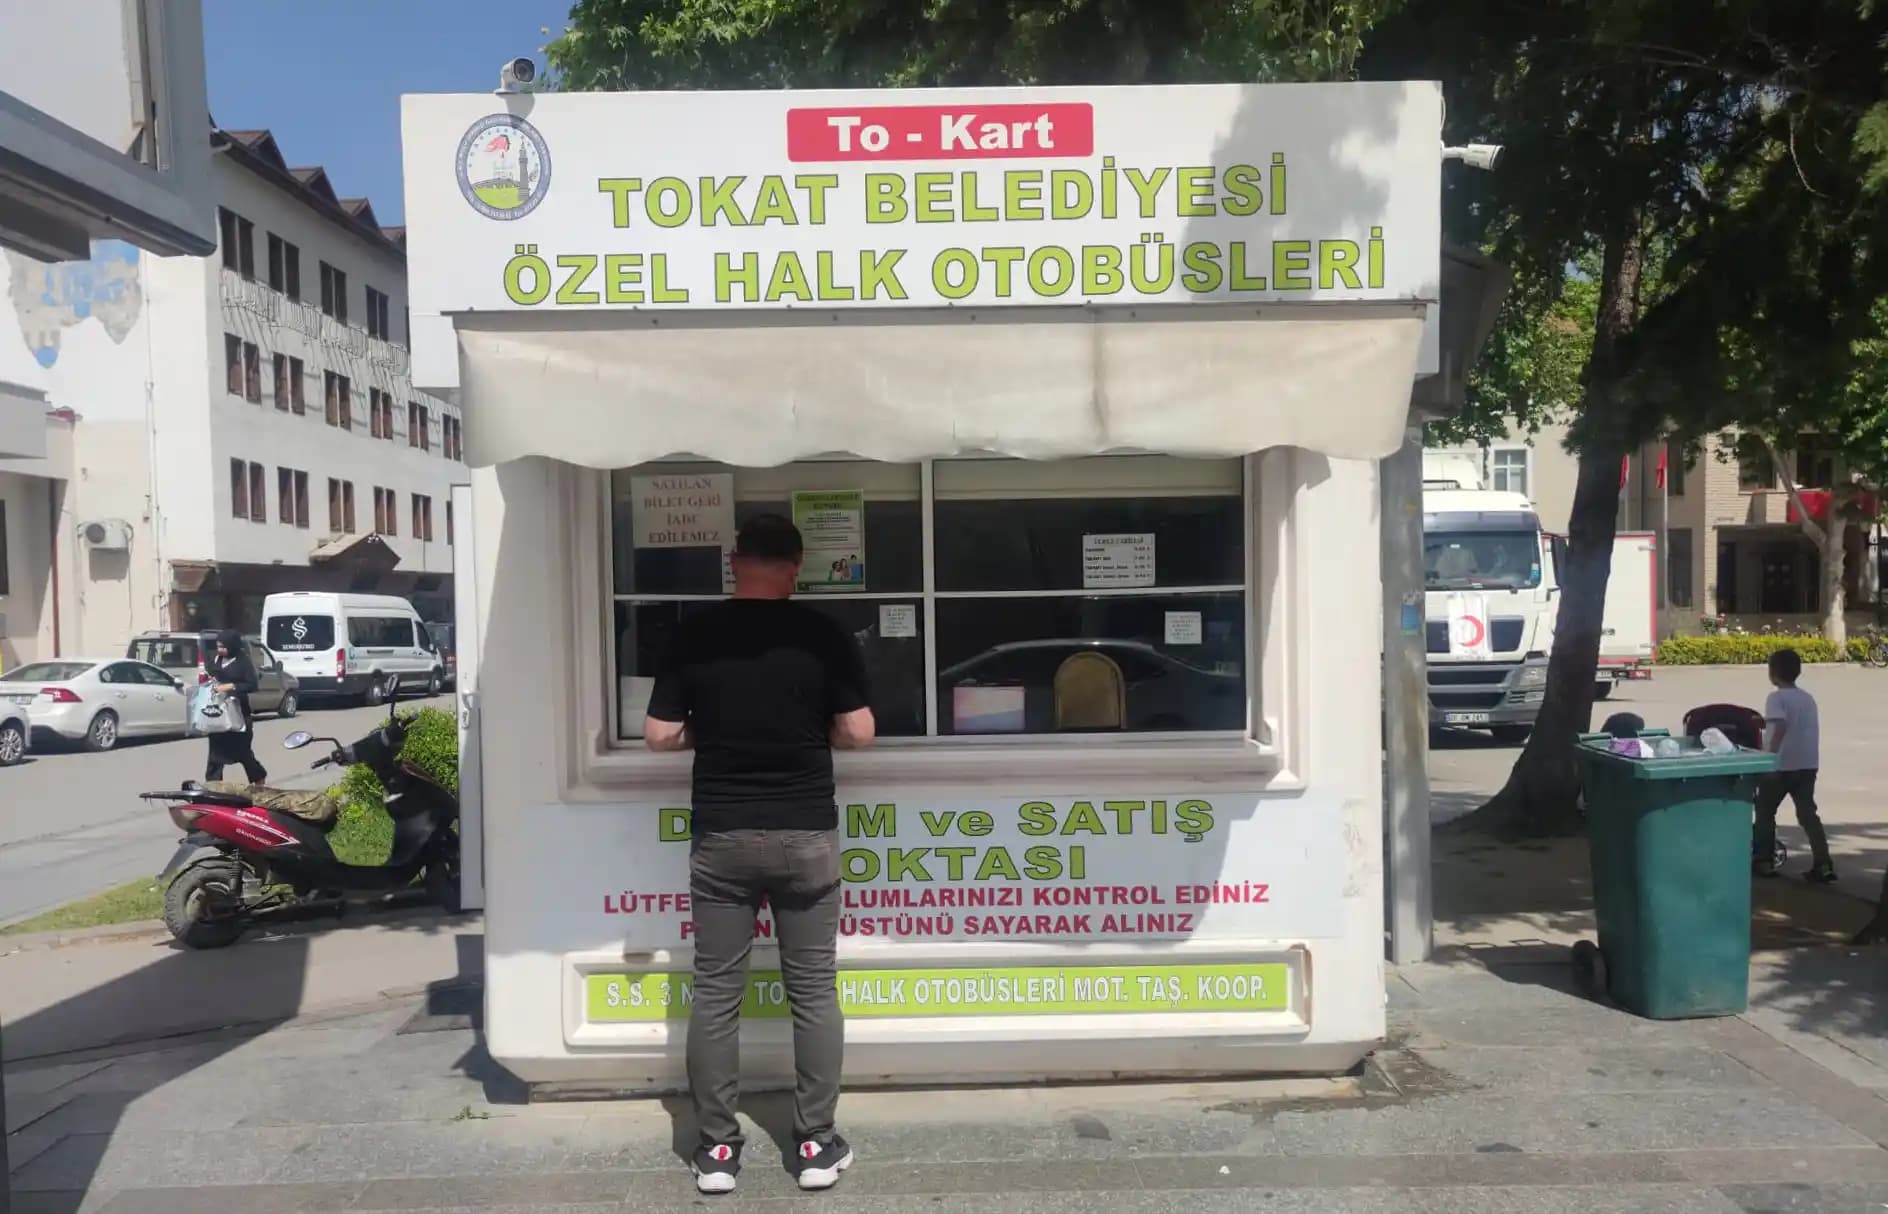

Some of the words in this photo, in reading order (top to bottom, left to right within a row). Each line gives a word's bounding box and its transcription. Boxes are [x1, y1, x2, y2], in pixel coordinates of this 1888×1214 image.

[827, 116, 890, 152] To
[940, 113, 1054, 150] Kart
[598, 173, 839, 228] TOKAT
[865, 152, 1287, 225] BELEDİYESİ
[503, 243, 690, 305] ÖZEL
[713, 248, 908, 303] HALK
[931, 226, 1385, 299] OTOBÜSLERİ
[919, 810, 994, 837] ve
[1017, 799, 1214, 843] SATIŞ
[840, 845, 1086, 883] OKTASI
[603, 891, 691, 914] LÜTFE
[1033, 884, 1166, 907] KONTROL
[1175, 880, 1270, 904] EDİNİZ
[839, 912, 955, 936] ÜSTÜNÜ
[963, 914, 1092, 936] SAYARAK
[1100, 913, 1193, 934] ALINIZ
[607, 981, 649, 1008] S.S.
[660, 982, 672, 1007] 3
[841, 978, 907, 1005] HALK
[914, 970, 1065, 1005] OTOBÜSLERİ
[1073, 975, 1129, 1002] MOT.
[1136, 975, 1189, 1009] TAŞ.
[1197, 974, 1267, 1002] KOOP.
